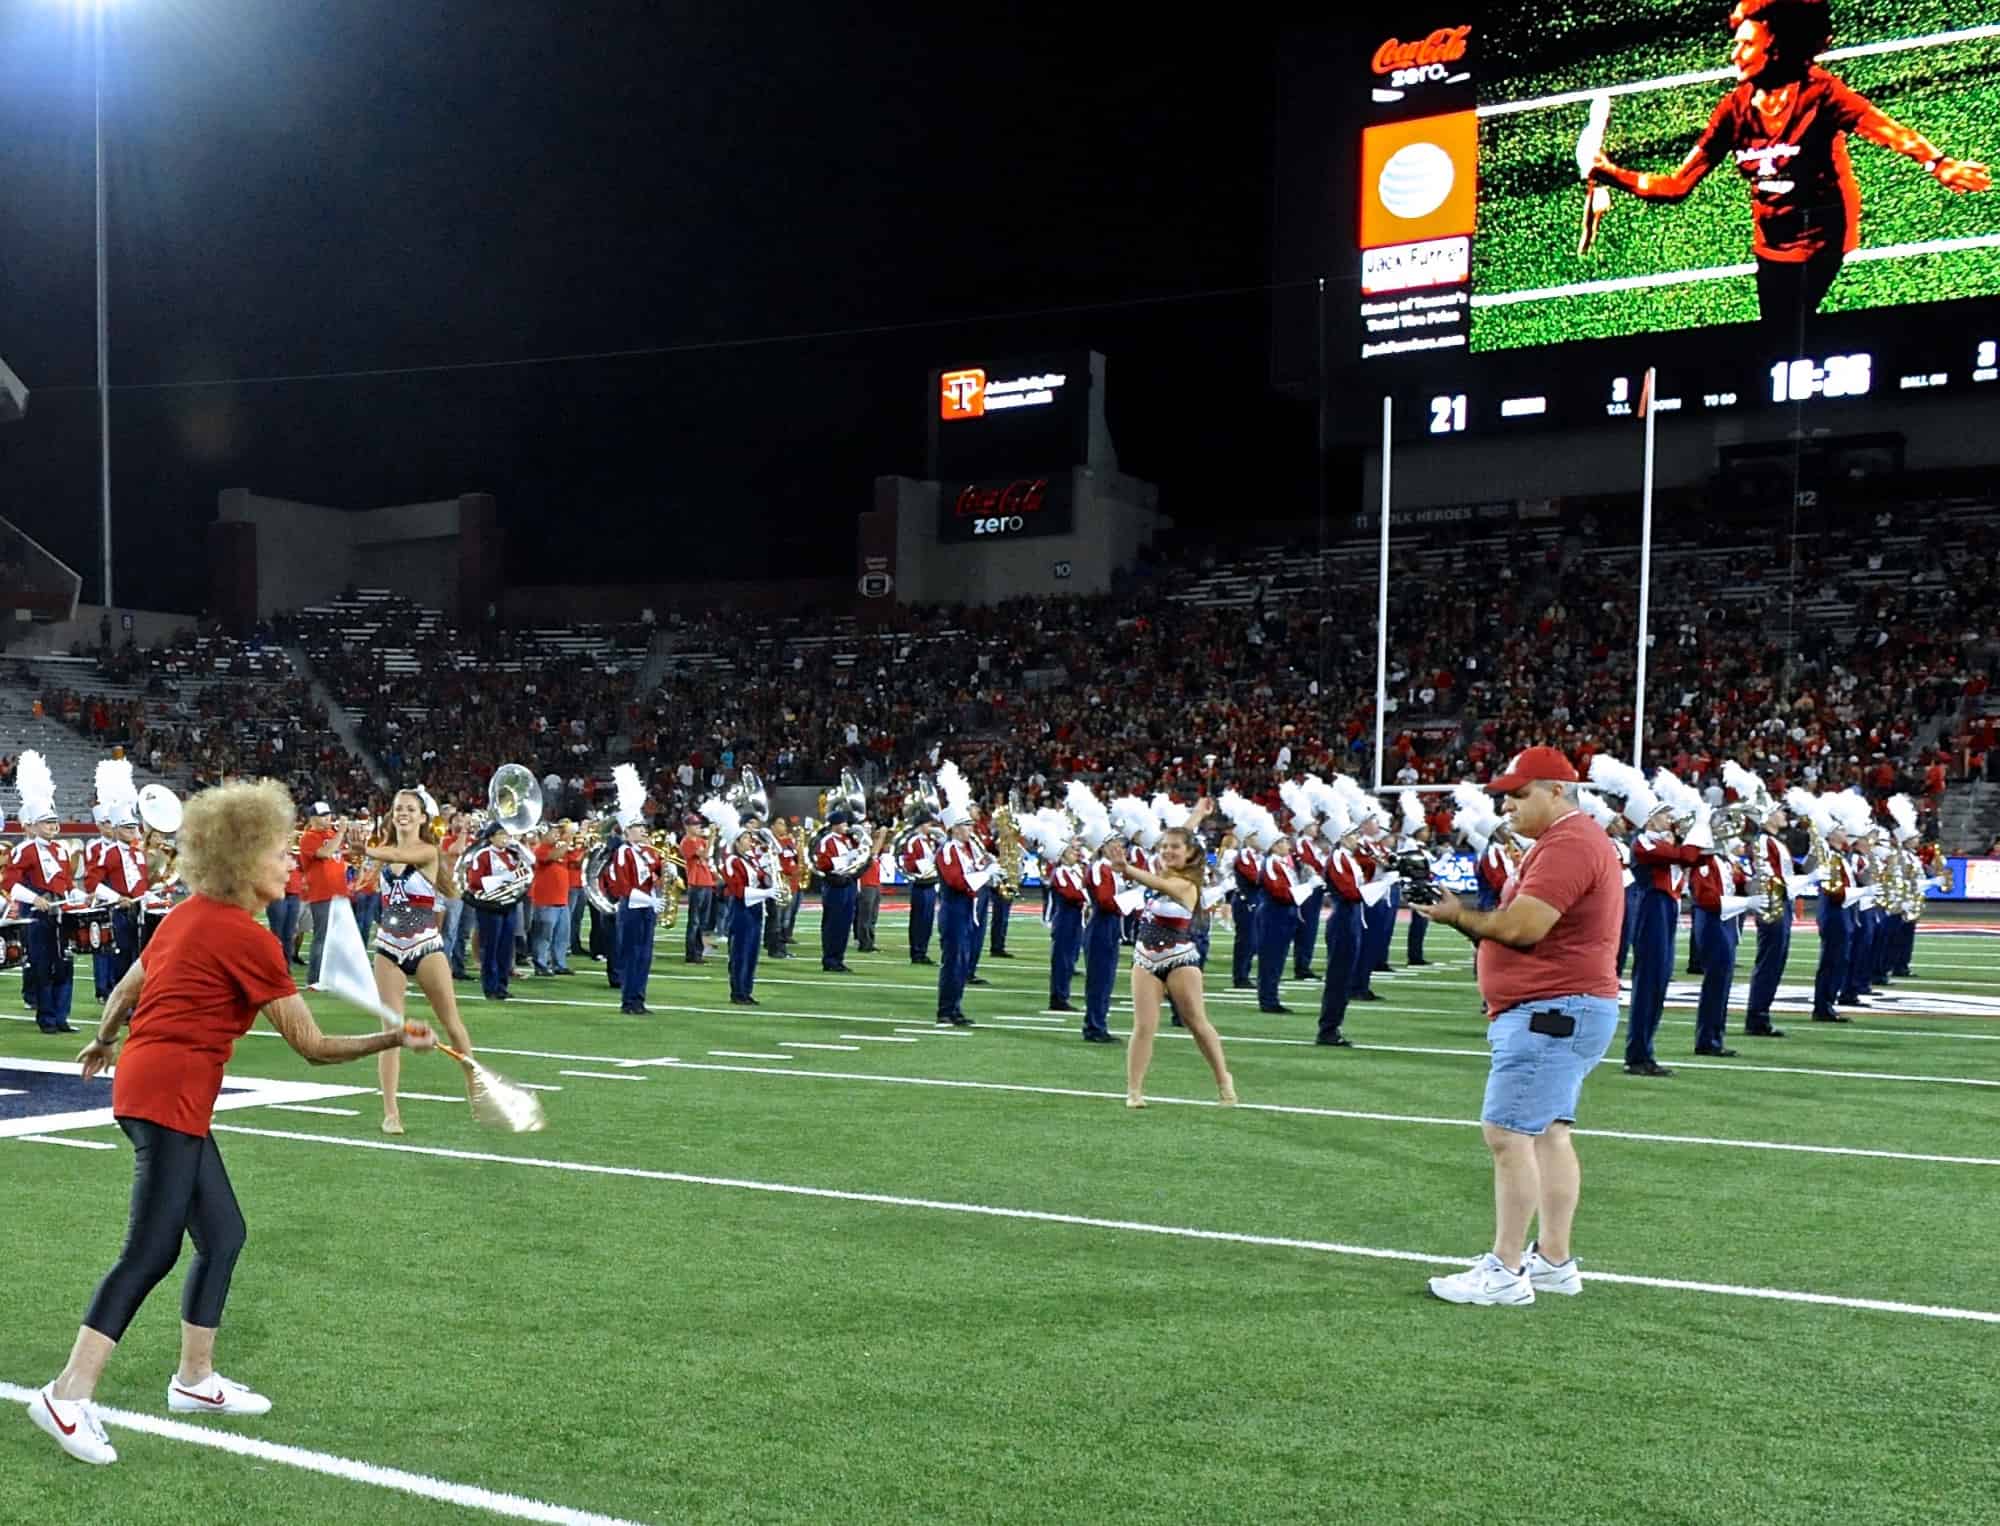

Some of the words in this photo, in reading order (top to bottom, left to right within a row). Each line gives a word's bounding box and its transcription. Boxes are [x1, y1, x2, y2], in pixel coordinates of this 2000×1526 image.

[1430, 394, 1467, 433] 21
[973, 515, 1024, 535] zero
[1055, 564, 1071, 577] 10
